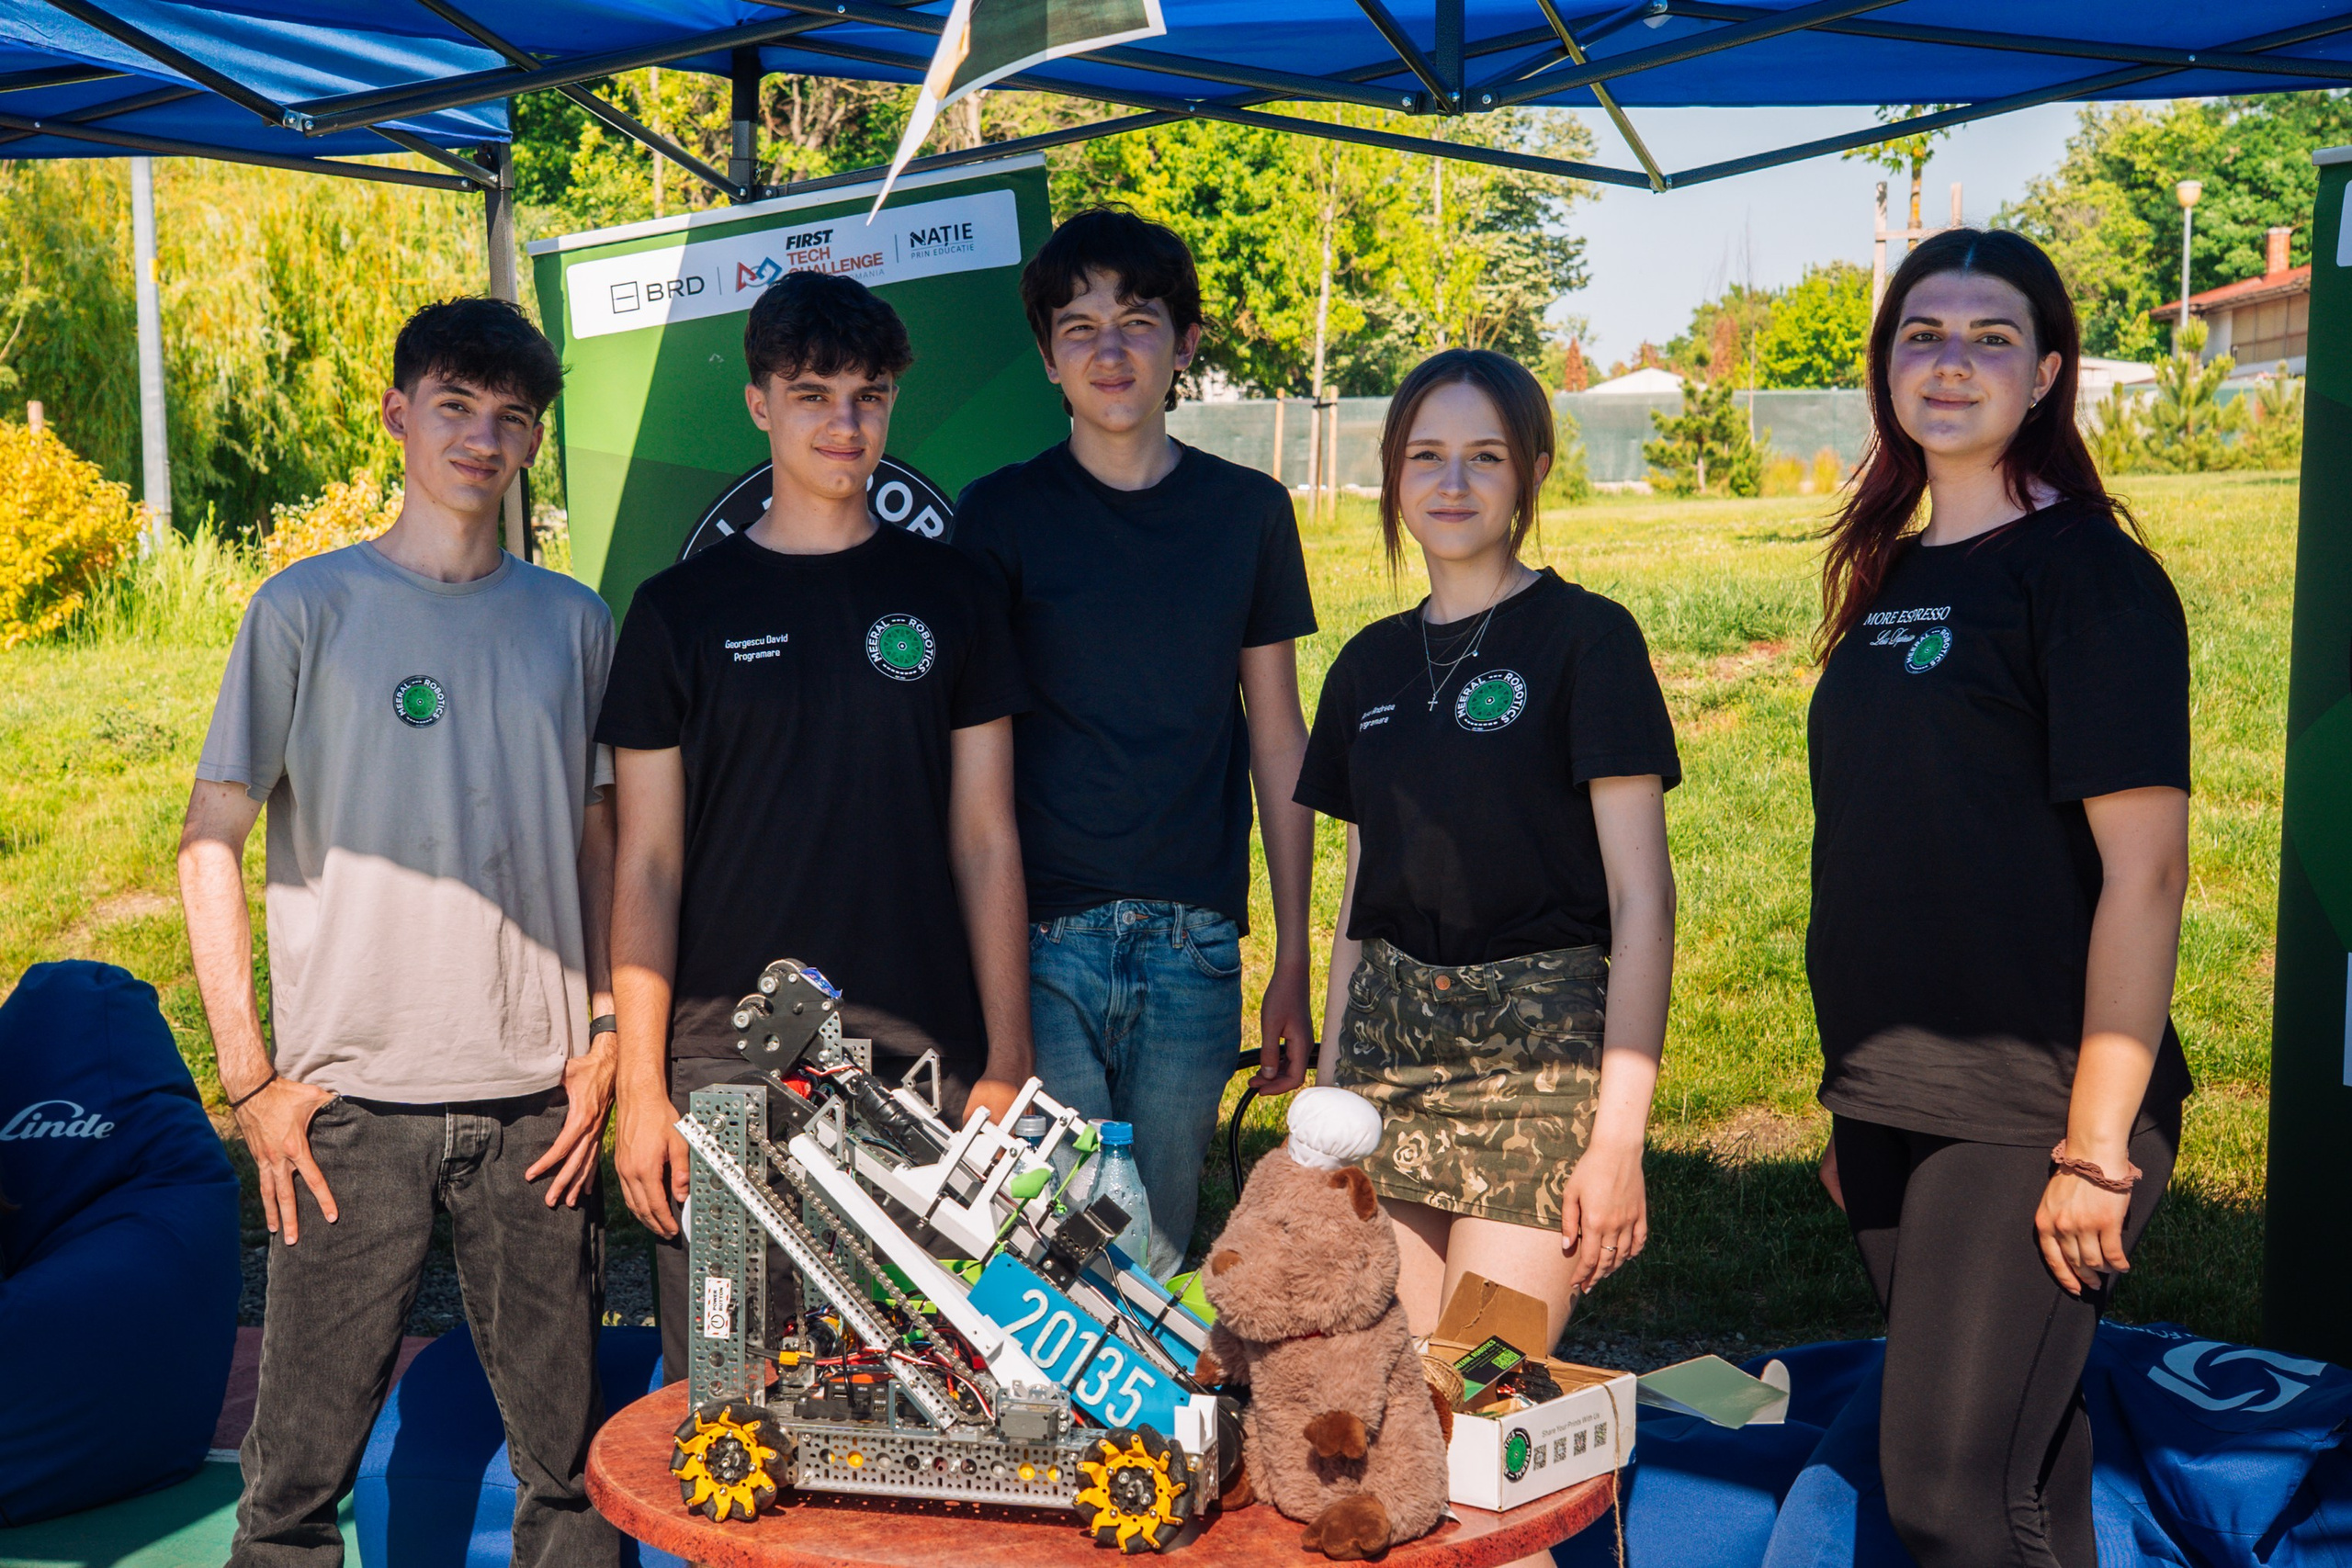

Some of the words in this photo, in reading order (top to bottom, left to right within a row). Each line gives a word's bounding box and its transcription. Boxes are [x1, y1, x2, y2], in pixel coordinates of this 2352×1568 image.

[786, 229, 833, 250] FIRST
[786, 246, 831, 265] TECH
[910, 251, 931, 260] PRIN
[646, 276, 705, 302] BRD
[1863, 611, 1899, 626] MORE
[1896, 606, 1951, 624] ESPRESSO
[725, 637, 765, 649] Georgescu
[766, 633, 788, 644] David
[868, 620, 890, 663] MEERAL
[908, 618, 933, 673] ROBOTICS
[734, 649, 781, 662] Programare
[395, 682, 412, 716] MEERAL
[424, 679, 446, 719] ROBOTICS
[1457, 677, 1486, 718] MEERAL
[1500, 672, 1524, 724] ROBOTICS
[0, 1100, 115, 1141] Linde
[1001, 1289, 1157, 1427] 20135
